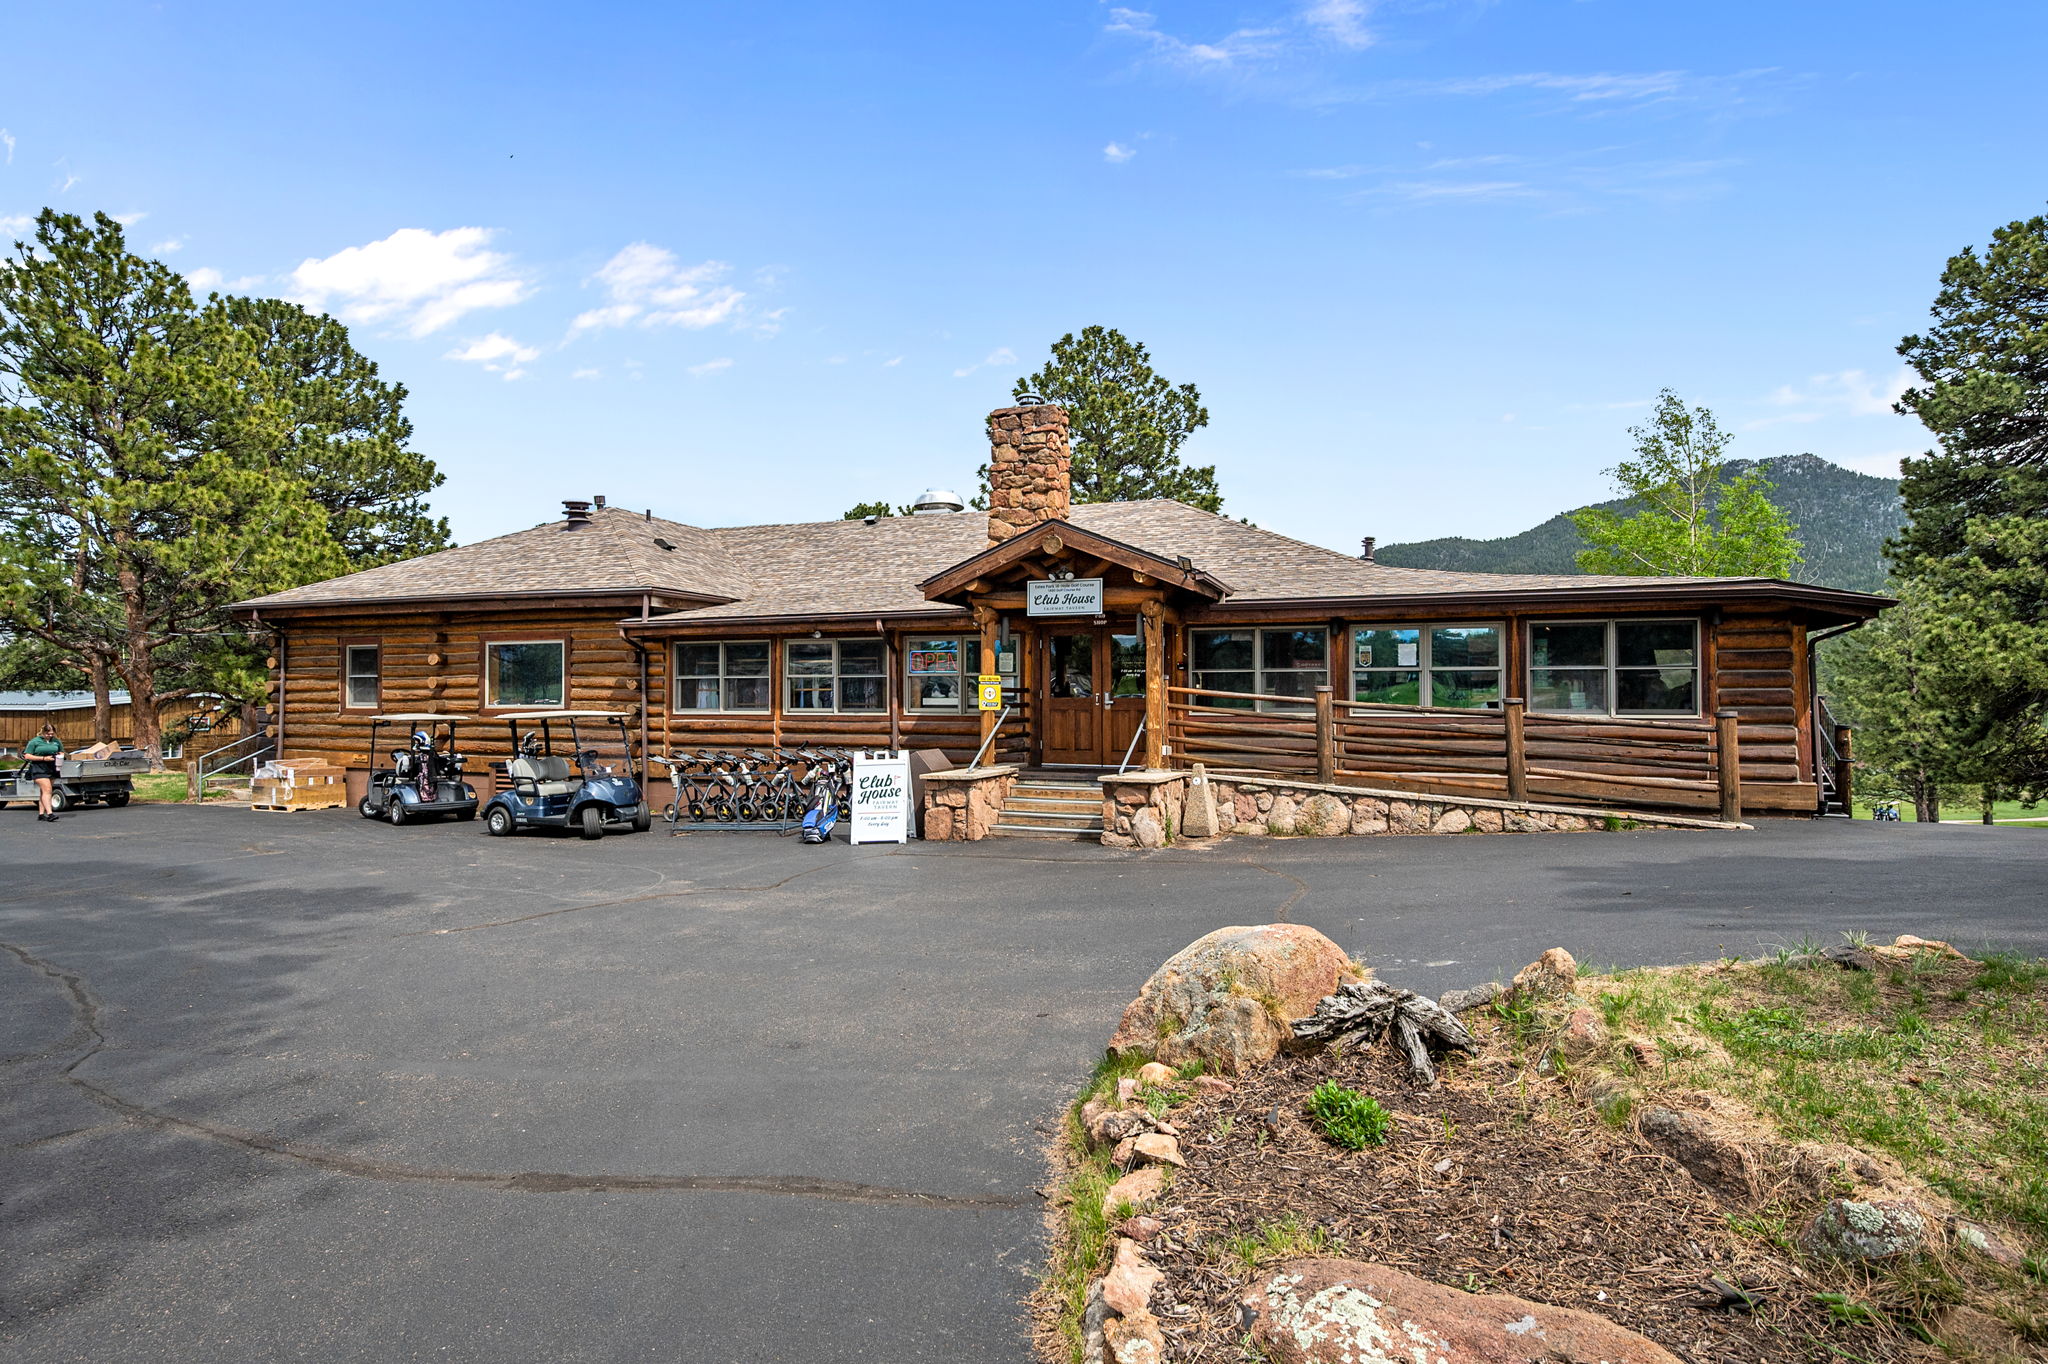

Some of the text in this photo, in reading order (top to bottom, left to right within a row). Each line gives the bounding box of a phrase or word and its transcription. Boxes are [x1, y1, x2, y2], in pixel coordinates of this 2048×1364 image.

[1034, 593, 1096, 605] Club House
[911, 653, 958, 671] OPEN
[859, 774, 893, 789] Club
[858, 787, 901, 805] House
